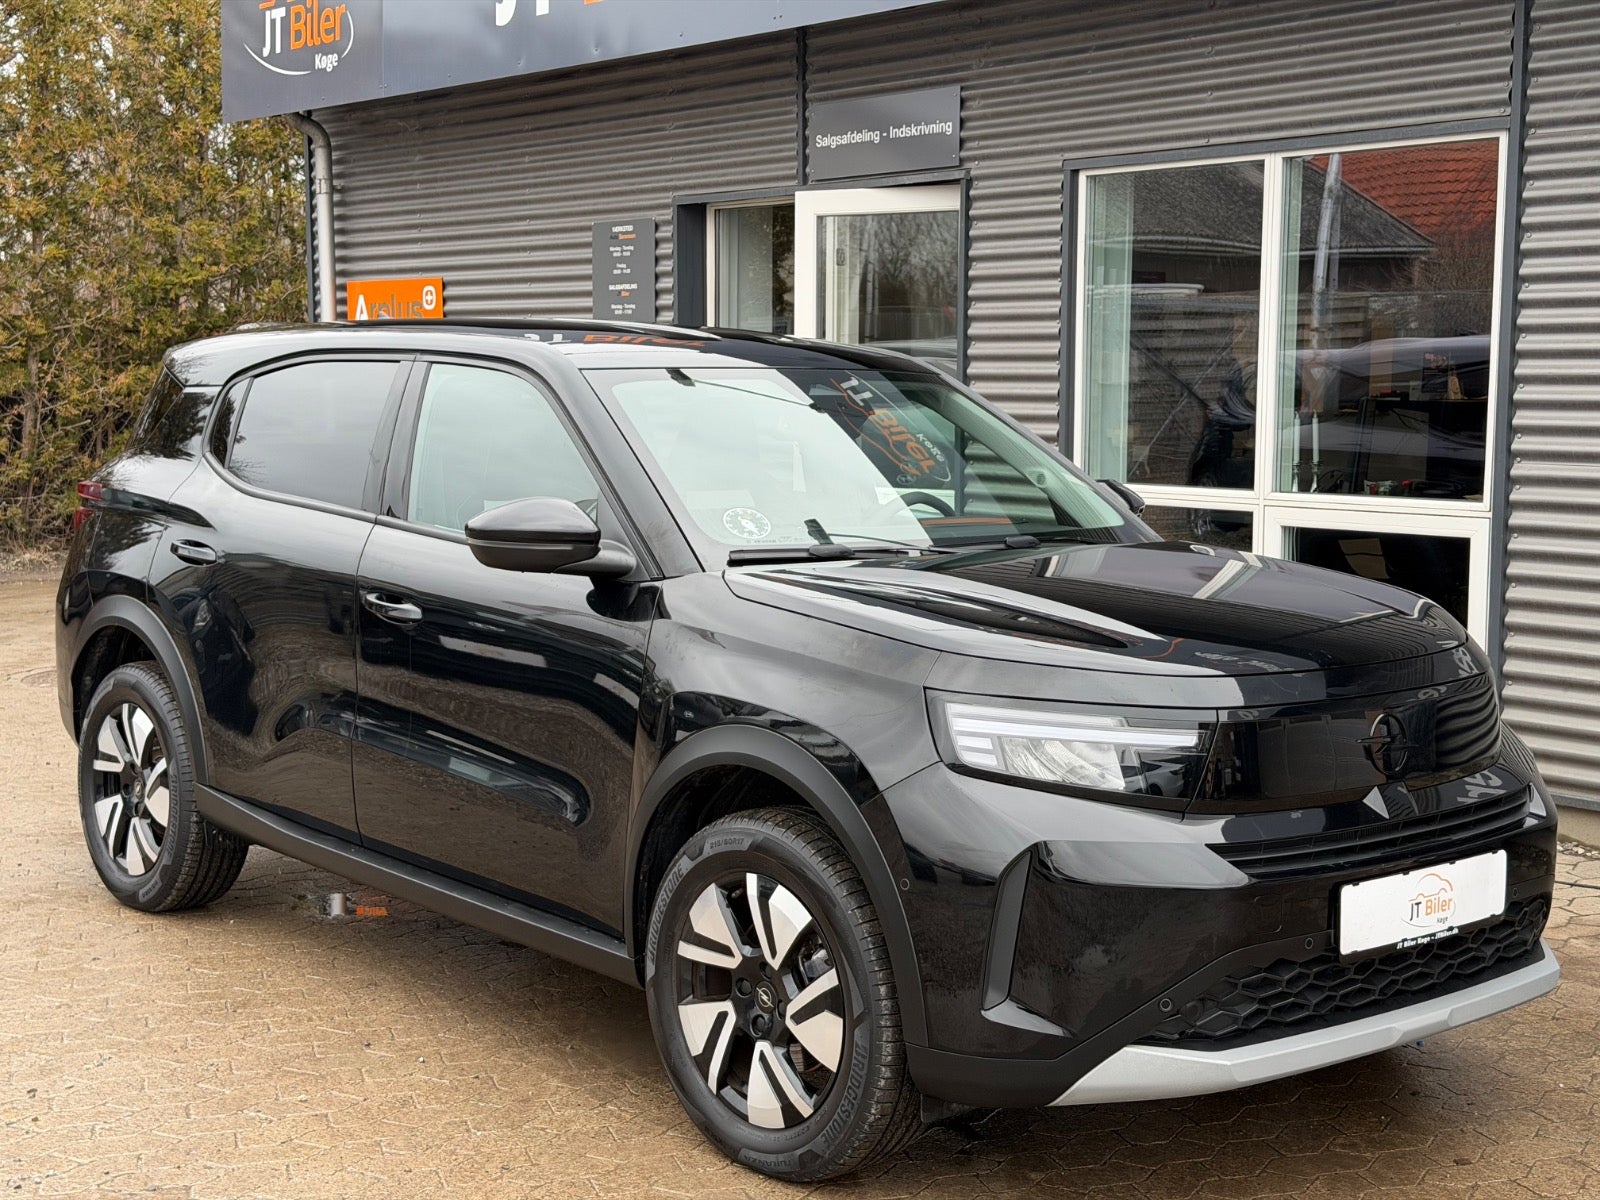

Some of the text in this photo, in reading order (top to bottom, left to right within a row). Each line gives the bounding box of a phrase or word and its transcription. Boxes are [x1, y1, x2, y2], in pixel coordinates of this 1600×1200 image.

[262, 0, 346, 57] JT Biler
[315, 53, 339, 73] Køge
[815, 129, 880, 148] Salgsafdeling
[889, 120, 952, 138] Indskrivning
[1409, 897, 1452, 922] JT Biler
